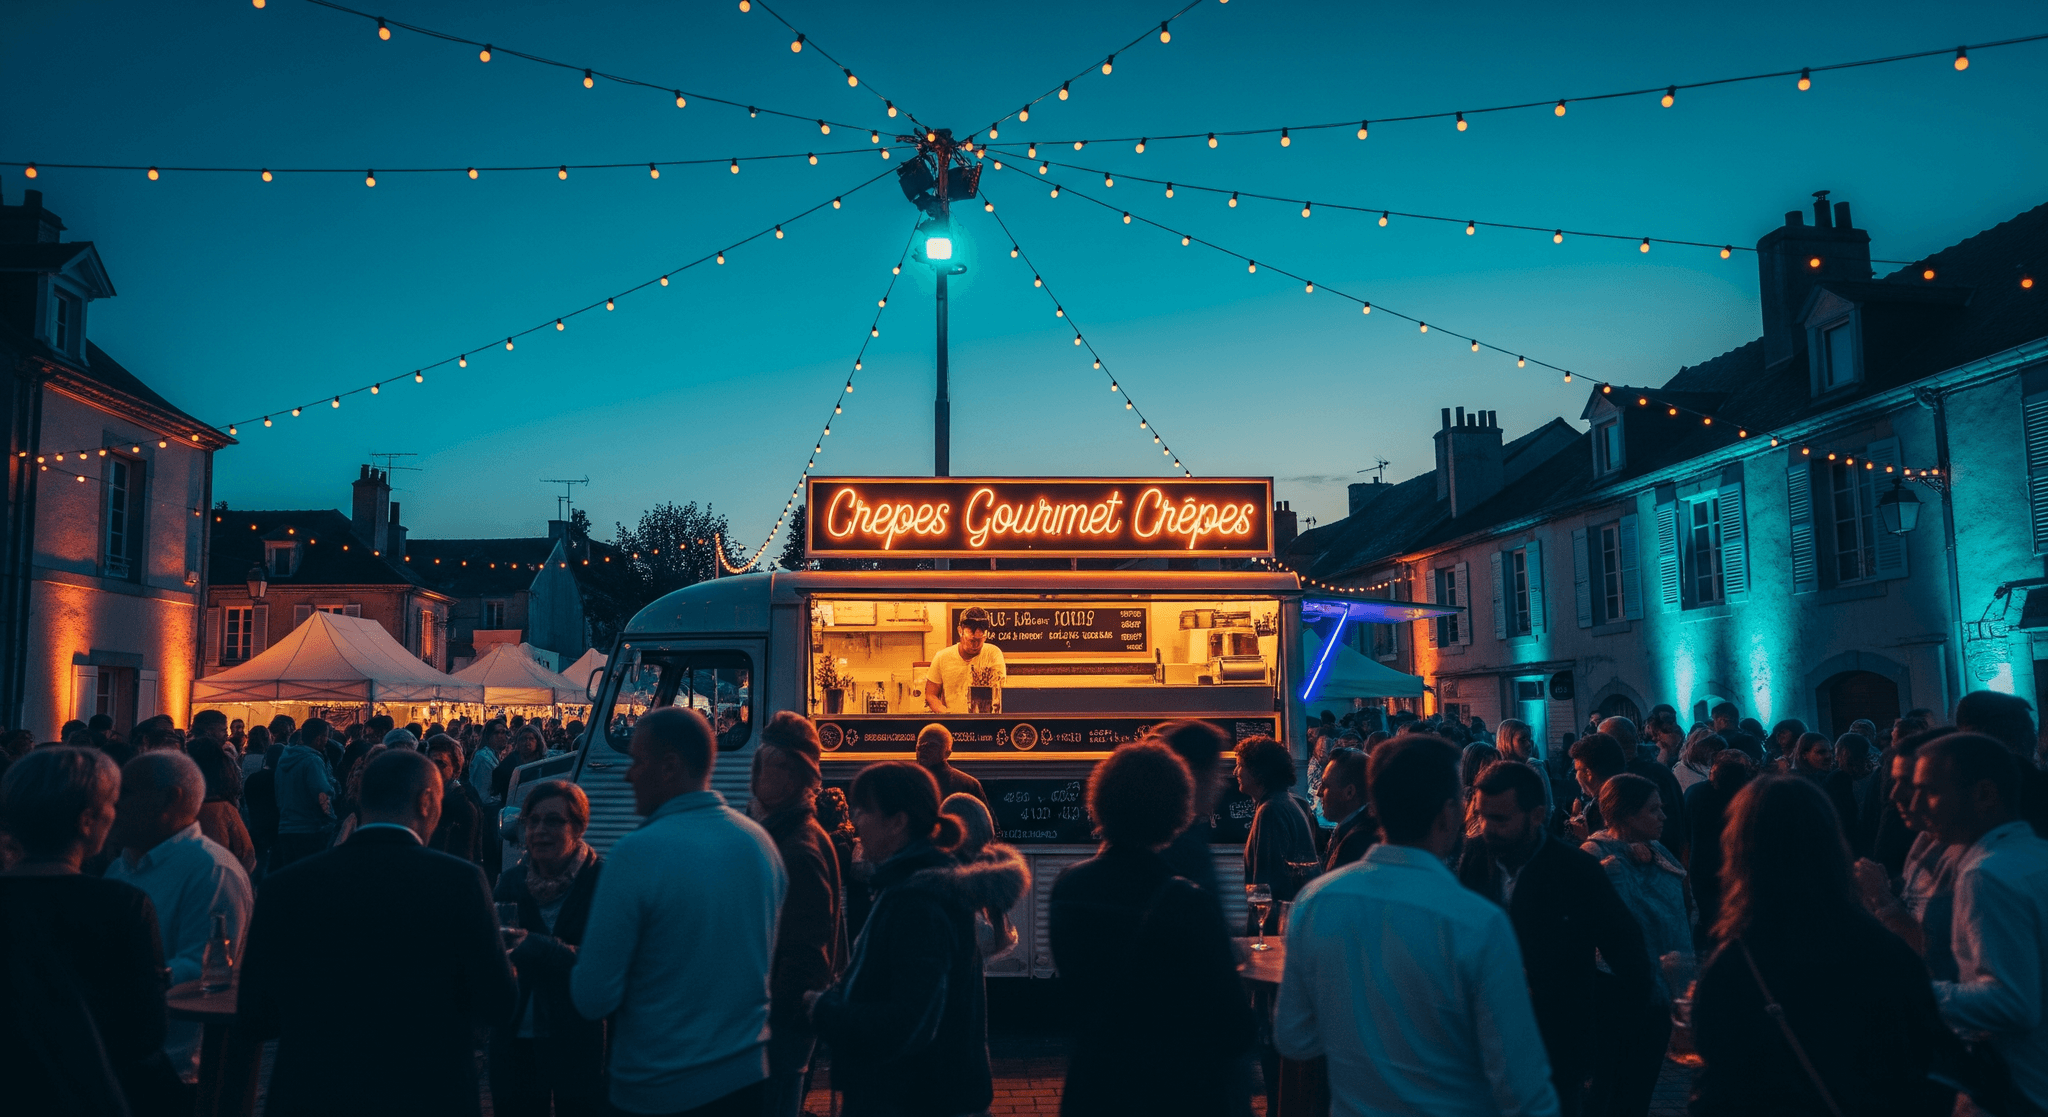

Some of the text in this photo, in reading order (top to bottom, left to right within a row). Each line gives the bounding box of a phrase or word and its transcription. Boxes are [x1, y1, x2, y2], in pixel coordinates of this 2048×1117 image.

[828, 487, 1255, 550] Crepes Gourmet Crêpes
